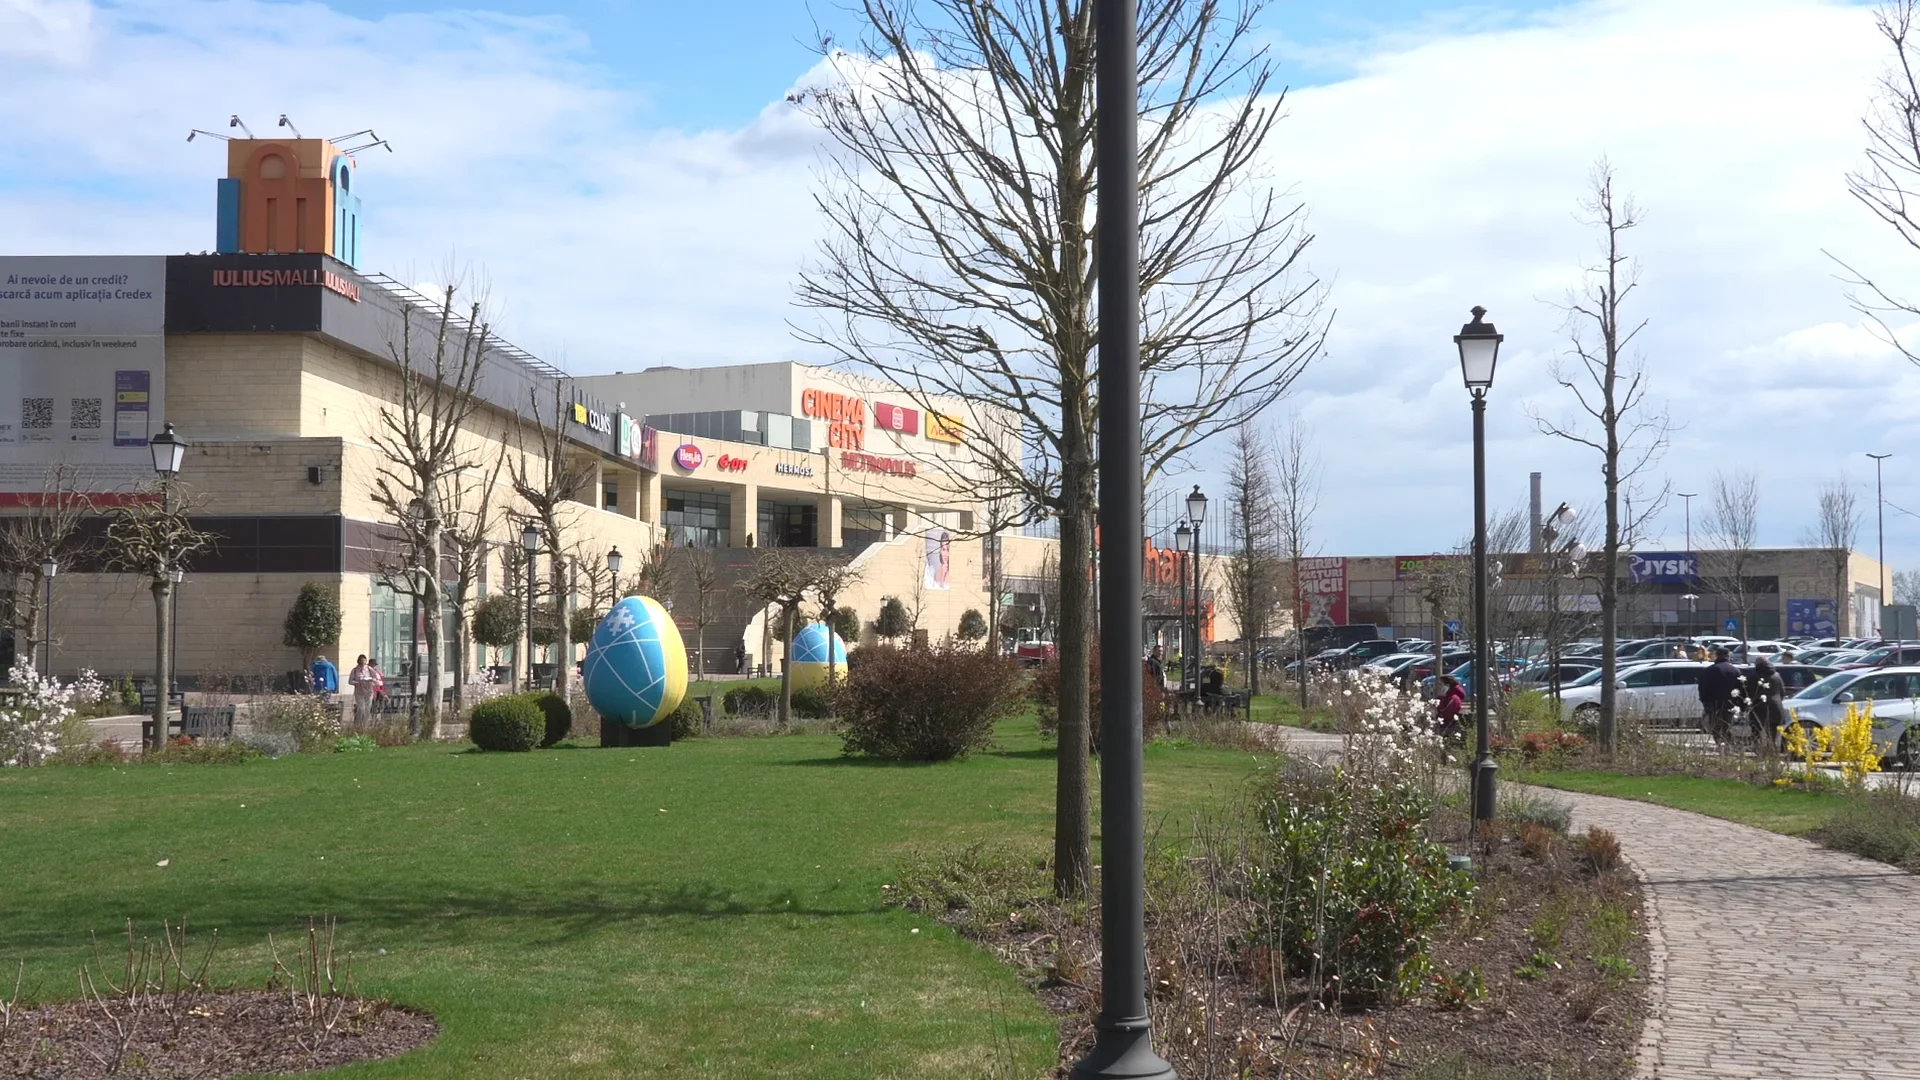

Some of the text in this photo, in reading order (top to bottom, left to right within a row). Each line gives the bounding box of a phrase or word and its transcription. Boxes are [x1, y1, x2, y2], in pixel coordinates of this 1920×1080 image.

[7, 274, 128, 285] Ai nevoie de un credit?
[34, 290, 63, 299] acum
[115, 288, 152, 299] Credex
[21, 320, 49, 328] instant
[10, 329, 25, 338] fixe
[0, 340, 27, 348] robare
[62, 339, 92, 348] inclusiv
[102, 340, 137, 348] weekend
[803, 387, 865, 424] CINEMA
[828, 423, 866, 451] CITY
[776, 463, 814, 477] HERMOSA
[841, 451, 917, 479] METROPOLIS
[1641, 559, 1694, 576] JYSK
